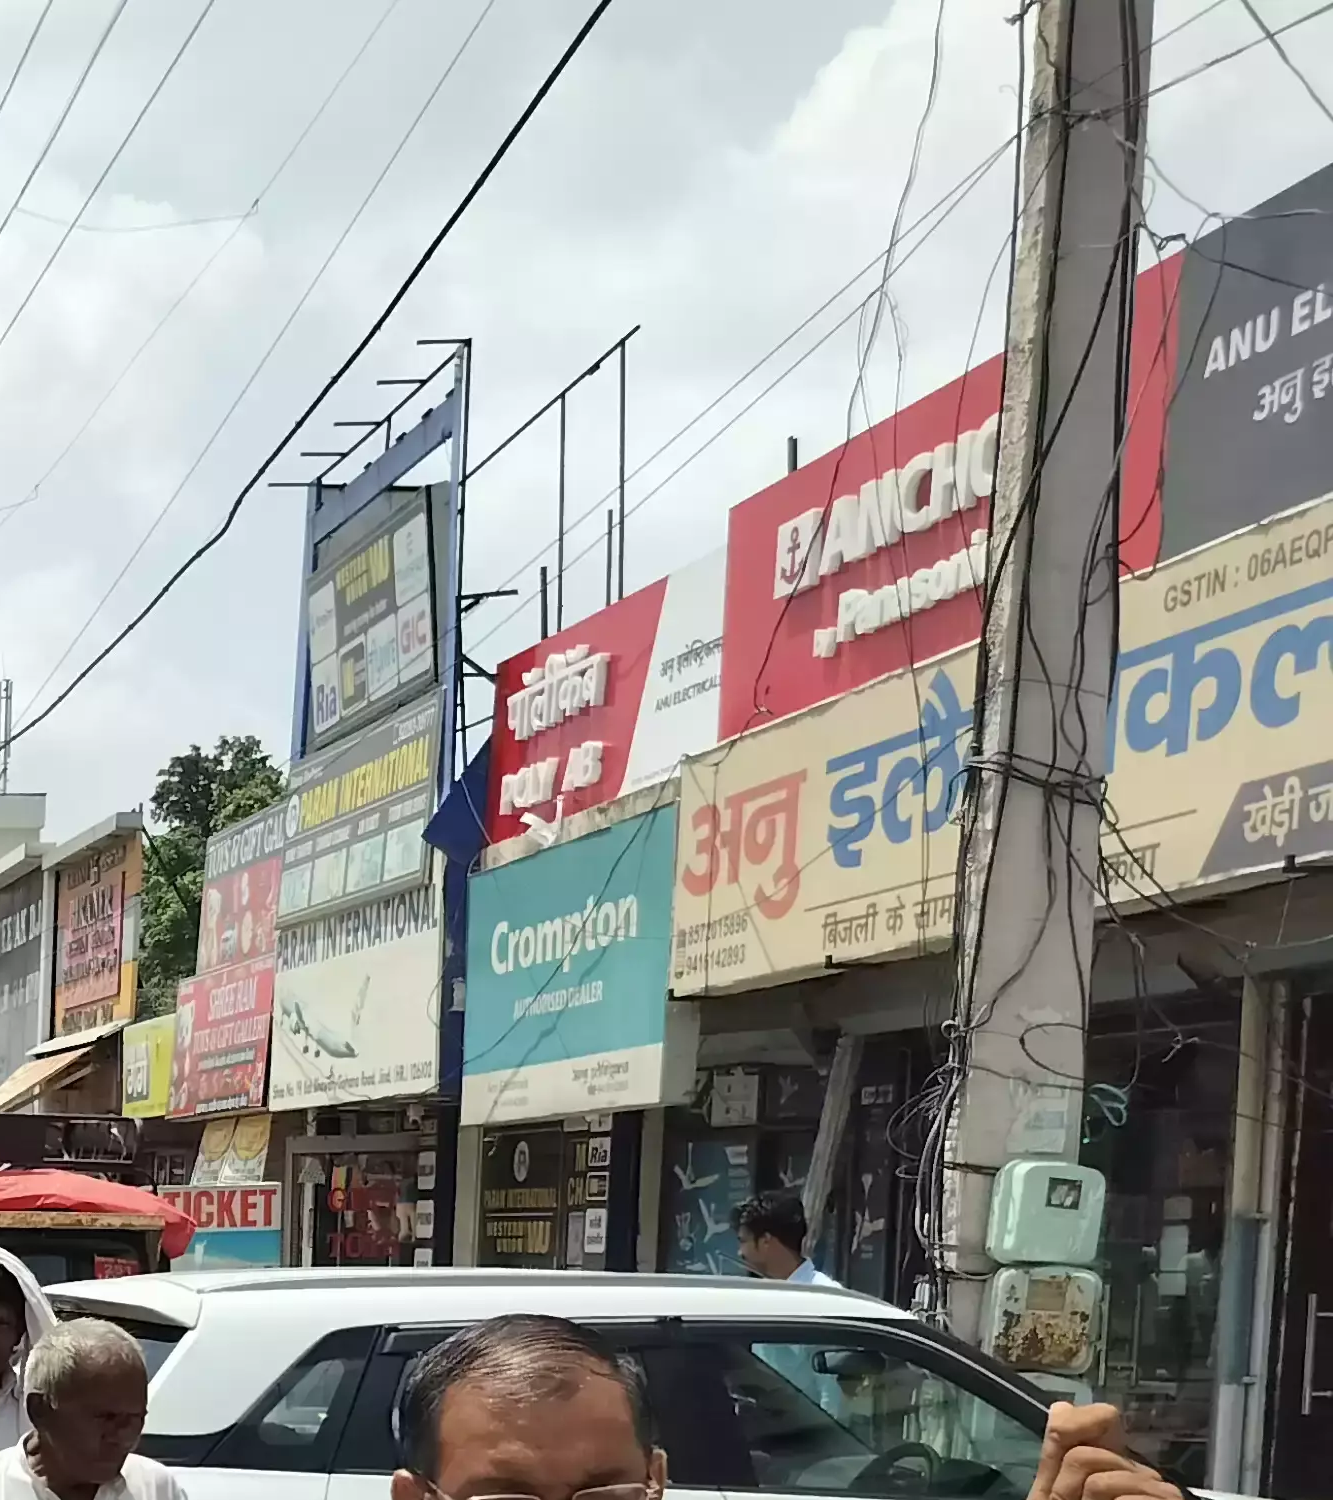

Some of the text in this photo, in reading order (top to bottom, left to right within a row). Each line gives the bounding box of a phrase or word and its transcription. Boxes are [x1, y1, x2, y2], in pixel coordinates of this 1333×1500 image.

[1203, 306, 1280, 380] ANU
[1253, 366, 1305, 424] अनु
[819, 412, 1001, 577] ANCHO
[837, 528, 988, 643] Panasoni
[1163, 565, 1227, 613] GSTIN
[316, 683, 337, 726] Ria
[683, 768, 807, 920] अनु
[277, 883, 437, 973] PARAM INTERNATIONAL
[491, 894, 638, 975] Crompton
[822, 902, 878, 950] बिजली
[886, 893, 906, 936] के
[513, 980, 604, 1020] AUTHORISED DEALER
